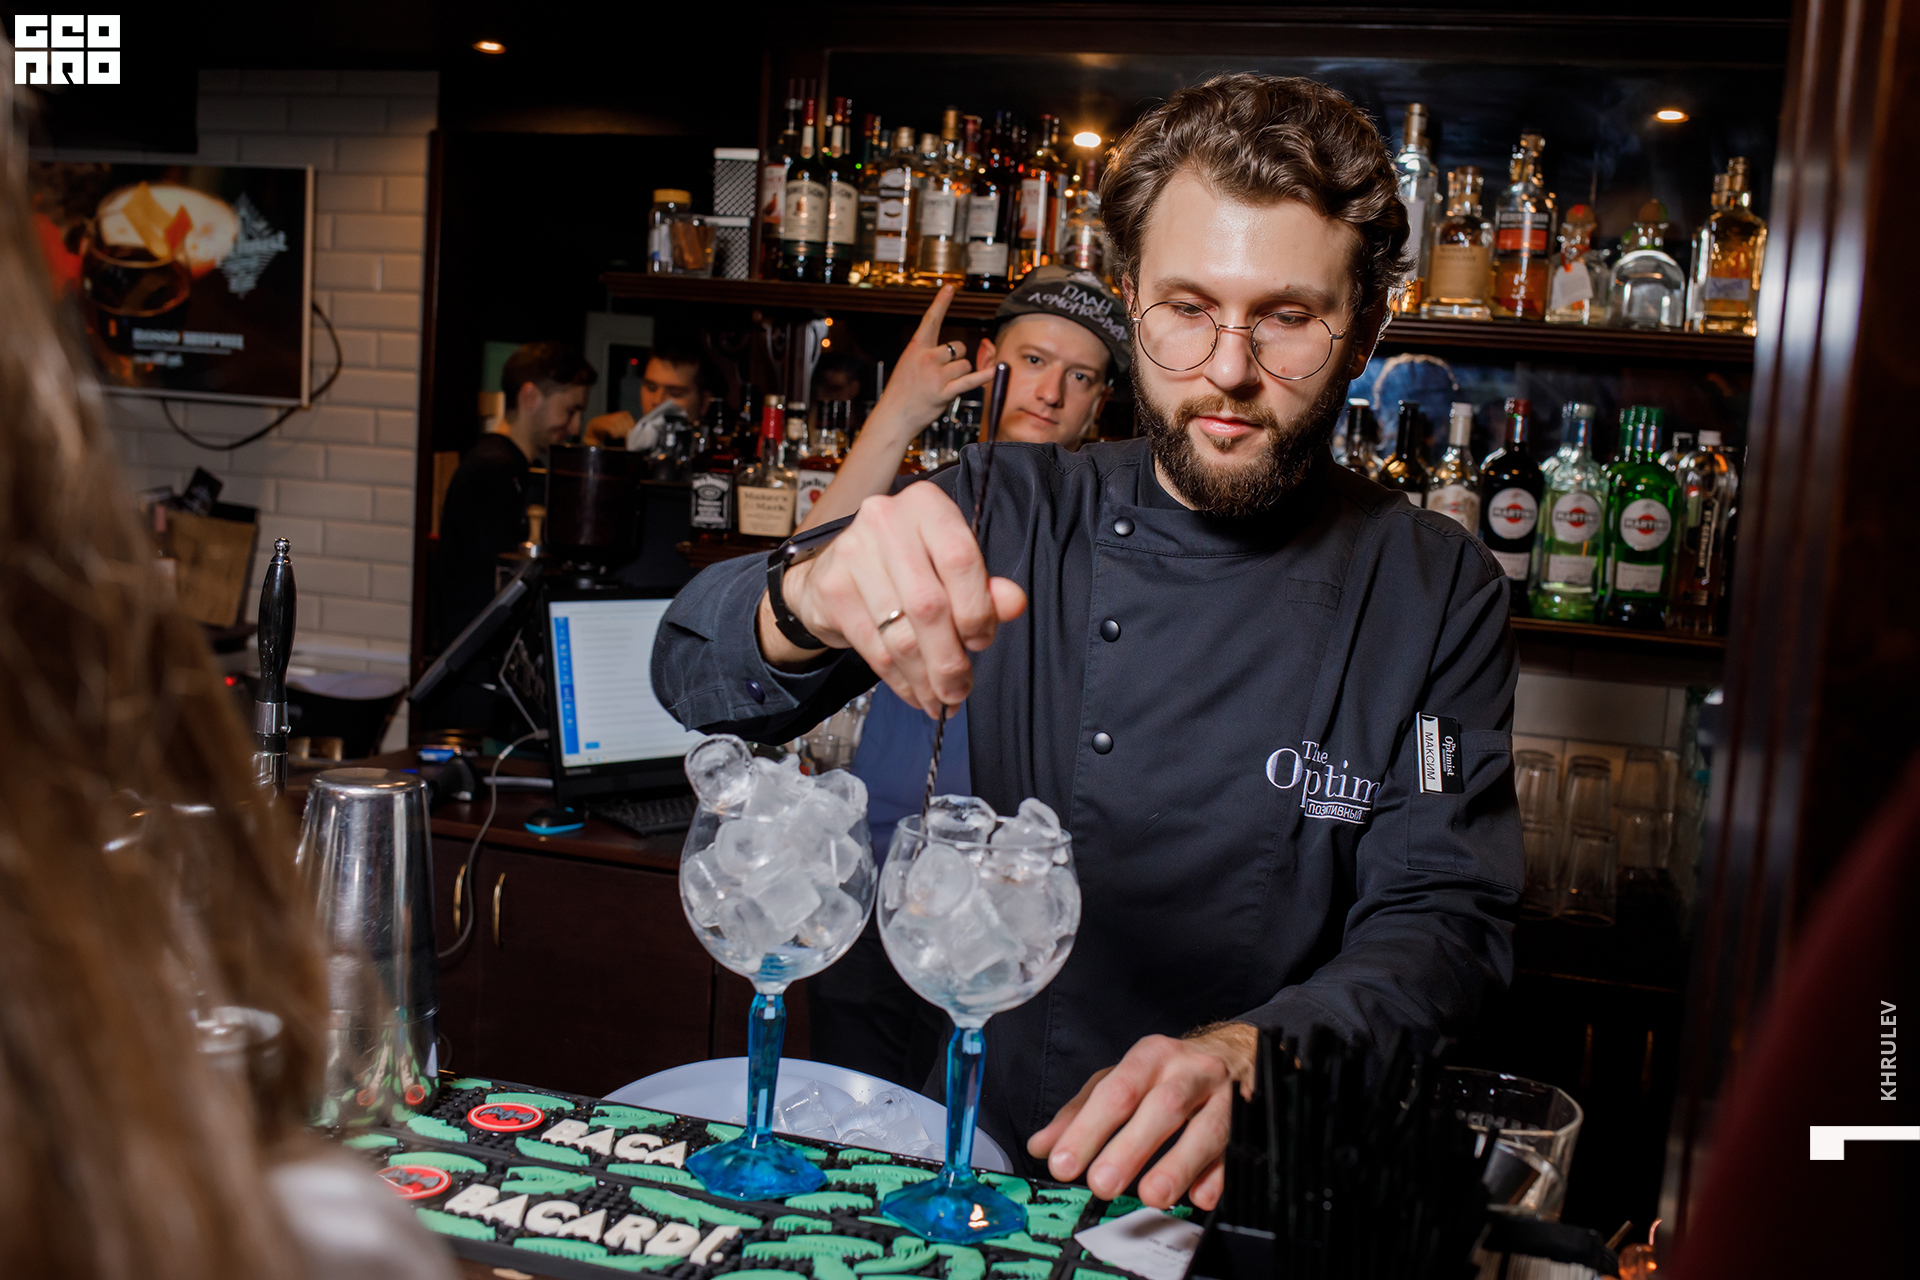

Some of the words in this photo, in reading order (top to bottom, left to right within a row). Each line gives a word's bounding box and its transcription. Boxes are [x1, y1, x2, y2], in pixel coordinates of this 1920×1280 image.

[1061, 284, 1113, 315] ПЛАН
[1302, 740, 1328, 764] The
[1425, 731, 1436, 780] МАКСИМ
[1442, 735, 1455, 777] Optimist
